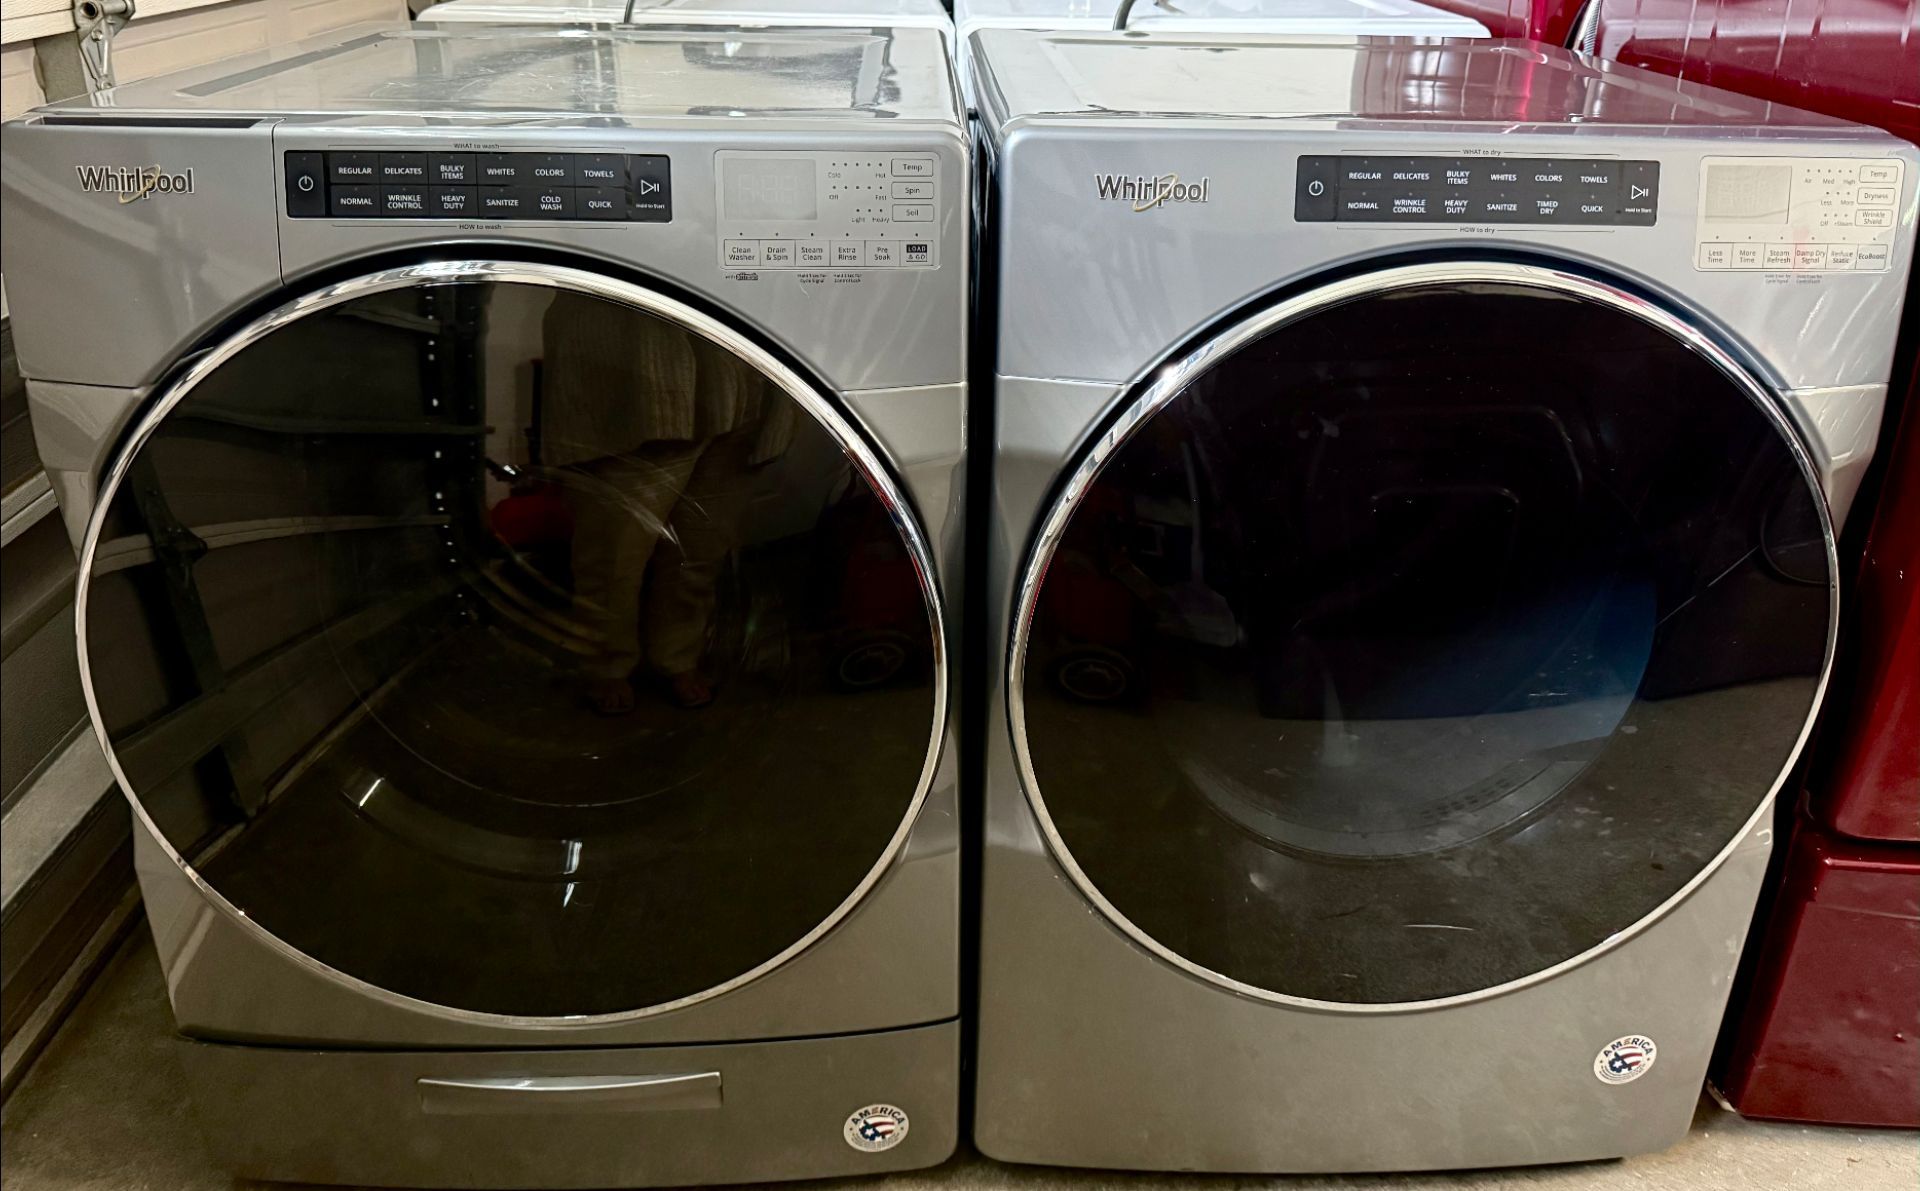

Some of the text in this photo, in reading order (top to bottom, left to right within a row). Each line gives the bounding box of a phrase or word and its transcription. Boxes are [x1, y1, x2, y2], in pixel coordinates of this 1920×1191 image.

[384, 167, 423, 175] DELICATES
[903, 163, 923, 172] Temp
[487, 168, 515, 176] WHITES
[535, 168, 565, 177] COLORS
[584, 170, 614, 178] TOWELS
[1348, 172, 1382, 180] REGULAR
[1393, 172, 1430, 180] DELICATES
[1535, 174, 1563, 182] COLORS
[76, 165, 194, 201] Whirlpool
[905, 187, 920, 195] Spin
[1095, 174, 1209, 208] Whirlpool
[486, 199, 519, 207] SANITIZE
[588, 201, 613, 209] QUICK
[1486, 203, 1517, 211] SANITIZE
[905, 208, 919, 216] Soil
[1581, 205, 1603, 213] QUICK
[732, 246, 751, 254] Clean
[767, 246, 787, 254] Drain
[801, 246, 823, 254] Steam
[838, 246, 856, 254] Extra
[877, 246, 888, 254] Pre
[907, 245, 927, 253] LOAD
[1796, 249, 1826, 258] Damp Dry
[1858, 252, 1886, 260] EcoBoost
[773, 254, 788, 262] Spin
[1603, 1037, 1653, 1057] AMERICA
[851, 1106, 906, 1125] AMERICA
